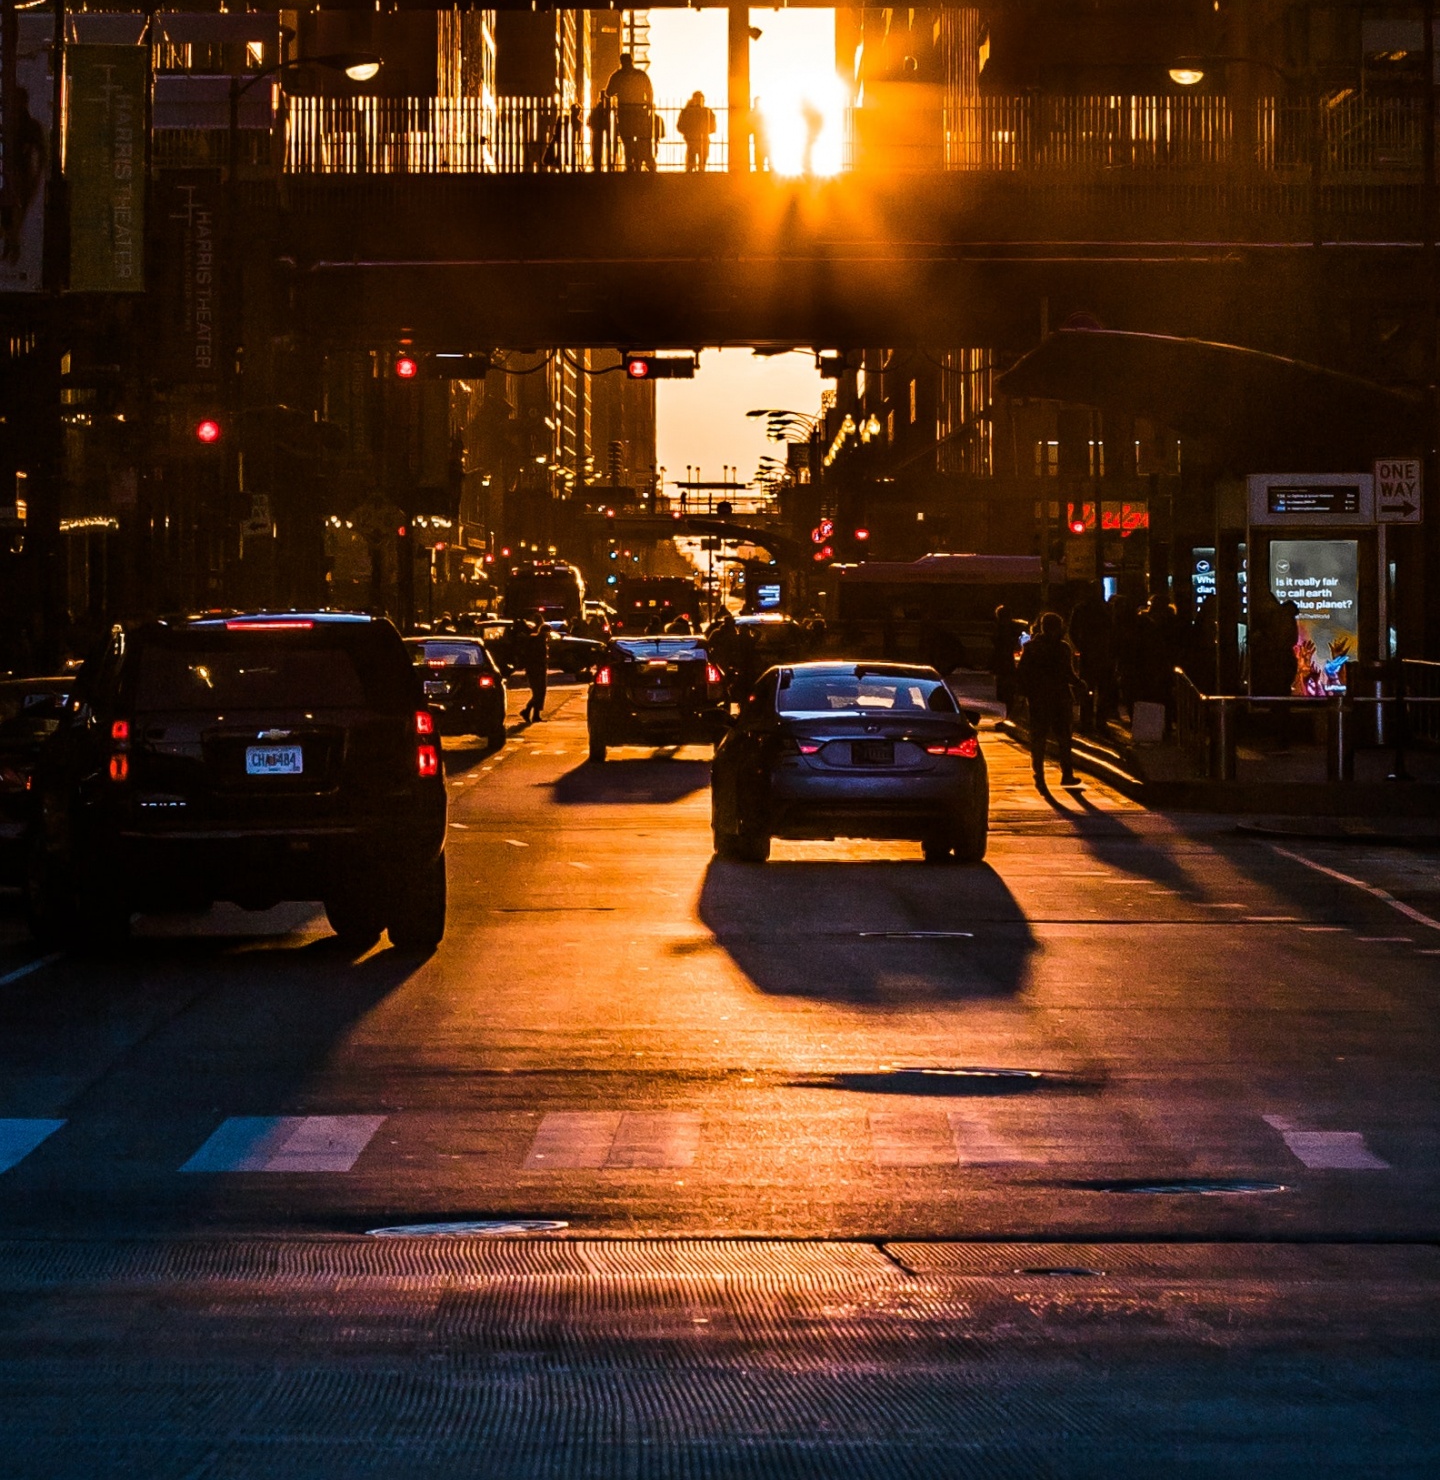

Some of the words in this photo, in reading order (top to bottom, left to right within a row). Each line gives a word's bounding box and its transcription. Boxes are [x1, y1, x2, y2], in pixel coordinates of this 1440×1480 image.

[113, 94, 133, 180] HARRIS
[113, 184, 133, 278] THEATER
[196, 211, 213, 284] HARRIS
[196, 289, 213, 369] THEATER
[1381, 464, 1416, 479] ONE
[1380, 482, 1416, 498] WAY
[1275, 577, 1285, 587] Is
[1286, 577, 1293, 587] it
[1294, 577, 1321, 588] really
[1322, 577, 1339, 587] fair
[1275, 589, 1287, 598] to
[1288, 589, 1305, 598] call
[1306, 589, 1333, 598] earth
[1316, 600, 1353, 611] planet?
